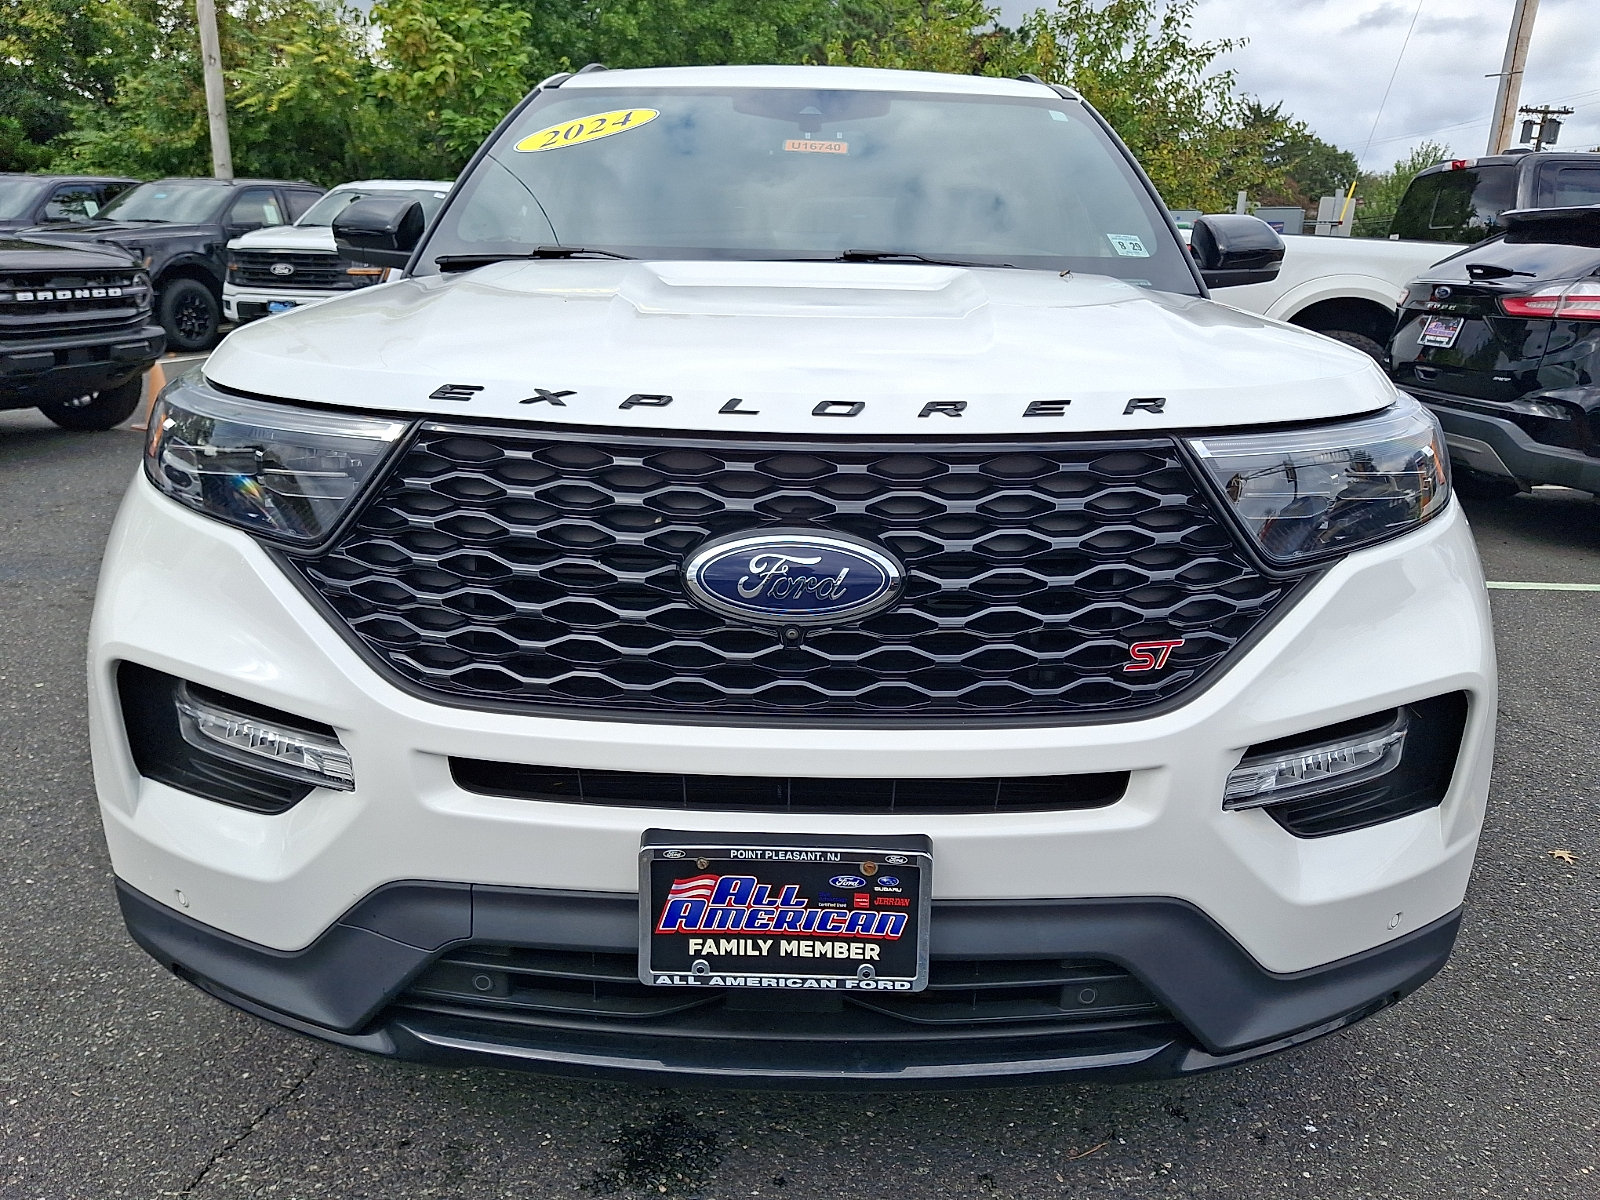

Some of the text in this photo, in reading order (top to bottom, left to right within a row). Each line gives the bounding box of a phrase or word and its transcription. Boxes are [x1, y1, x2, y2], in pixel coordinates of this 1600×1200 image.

[539, 111, 633, 148] 2024
[791, 142, 841, 152] U16740
[1118, 241, 1143, 252] 8 29
[16, 287, 122, 301] BRONCO
[428, 383, 1167, 418] EXPLORER
[737, 553, 850, 600] Ford
[1123, 639, 1185, 672] ST
[730, 850, 841, 862] POINT PLEASANT, NJ
[710, 875, 808, 908] ALL
[657, 897, 909, 938] AMERICAN
[688, 939, 880, 960] FAMILY MEMBER
[656, 975, 911, 990] ALL AMERICAN FORD
